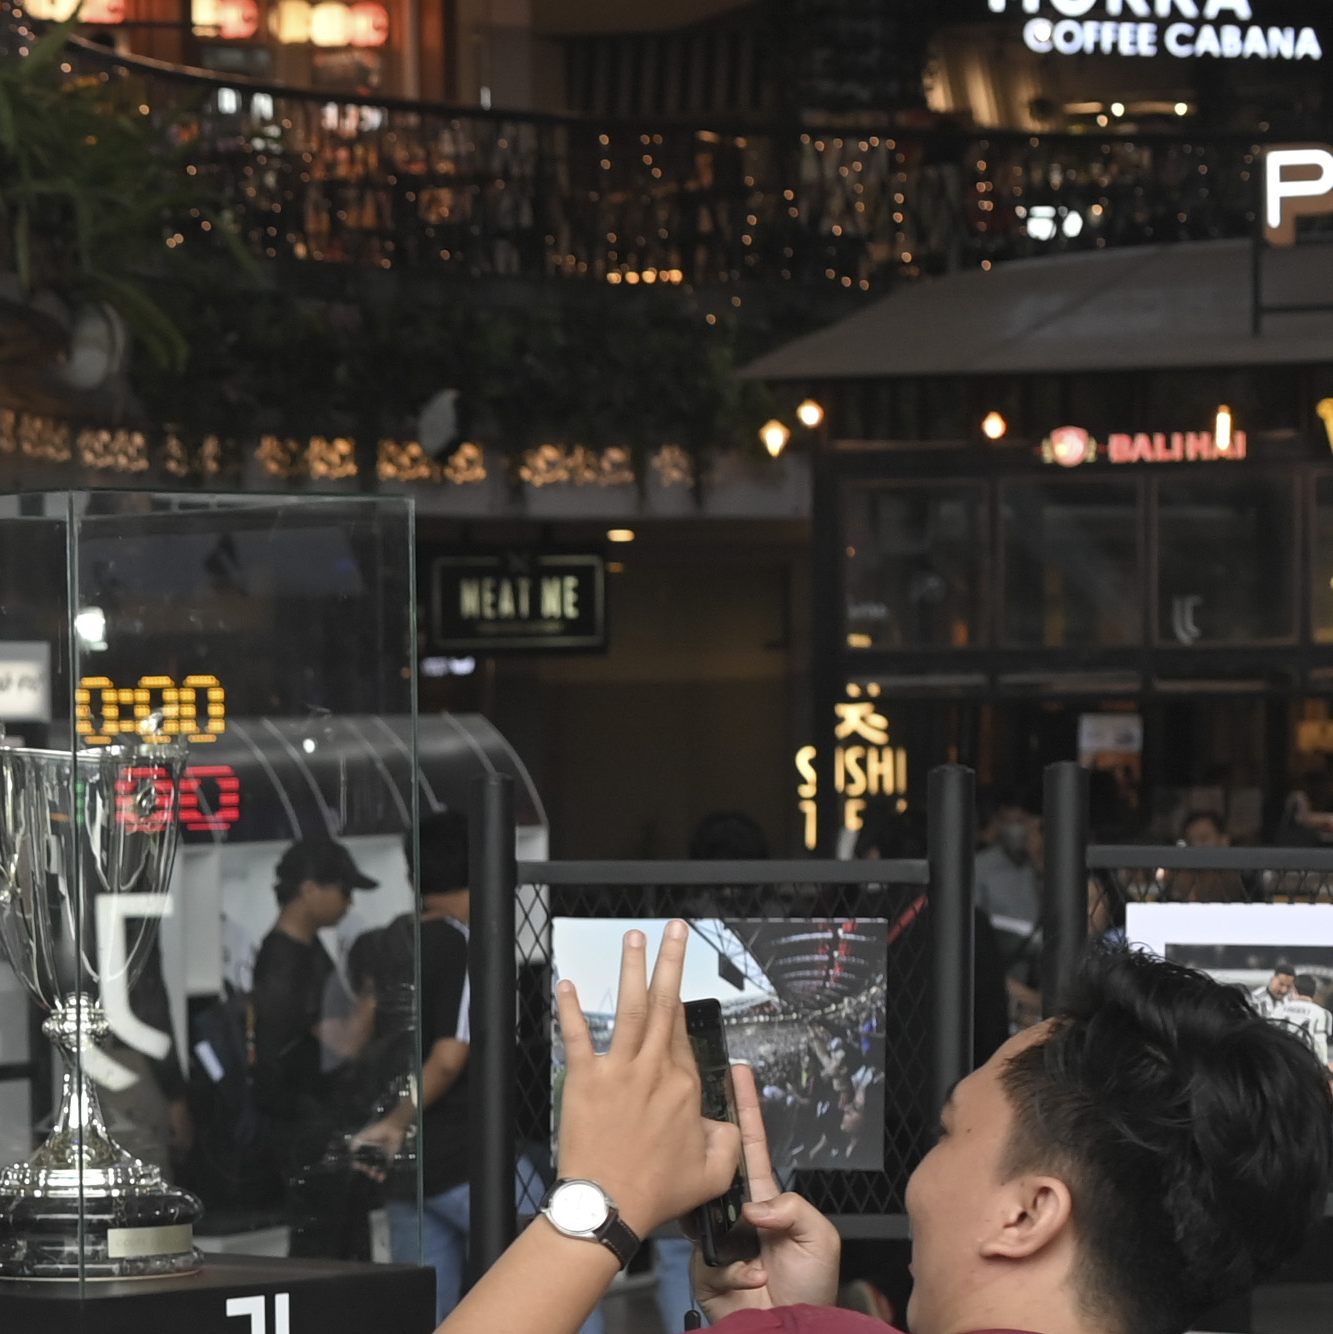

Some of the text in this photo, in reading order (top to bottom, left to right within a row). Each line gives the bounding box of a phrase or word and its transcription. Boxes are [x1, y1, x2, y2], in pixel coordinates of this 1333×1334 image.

[1023, 18, 1323, 60] COFFEE CABANA
[1108, 432, 1183, 463] BALI
